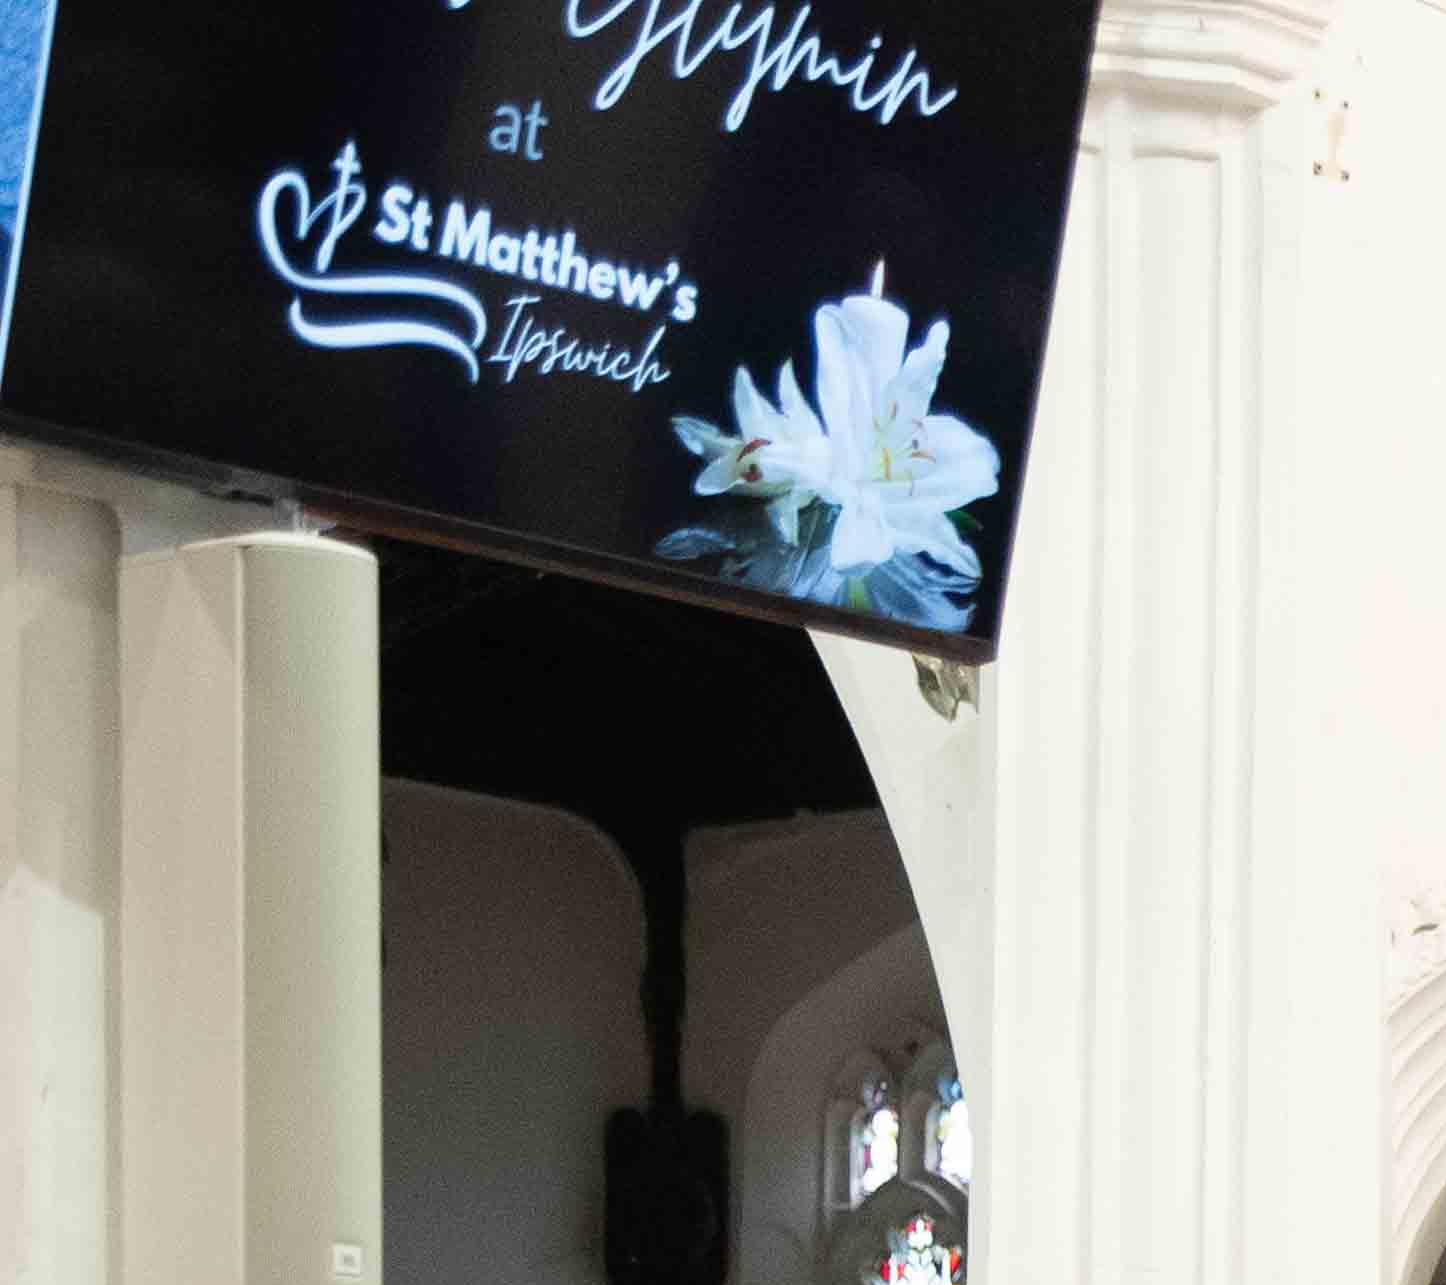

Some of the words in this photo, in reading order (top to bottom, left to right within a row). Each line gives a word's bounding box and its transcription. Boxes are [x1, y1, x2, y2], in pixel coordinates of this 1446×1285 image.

[488, 100, 549, 161] at
[374, 184, 433, 252] St
[438, 200, 699, 323] Matthew's
[490, 296, 672, 392] Ipswich
